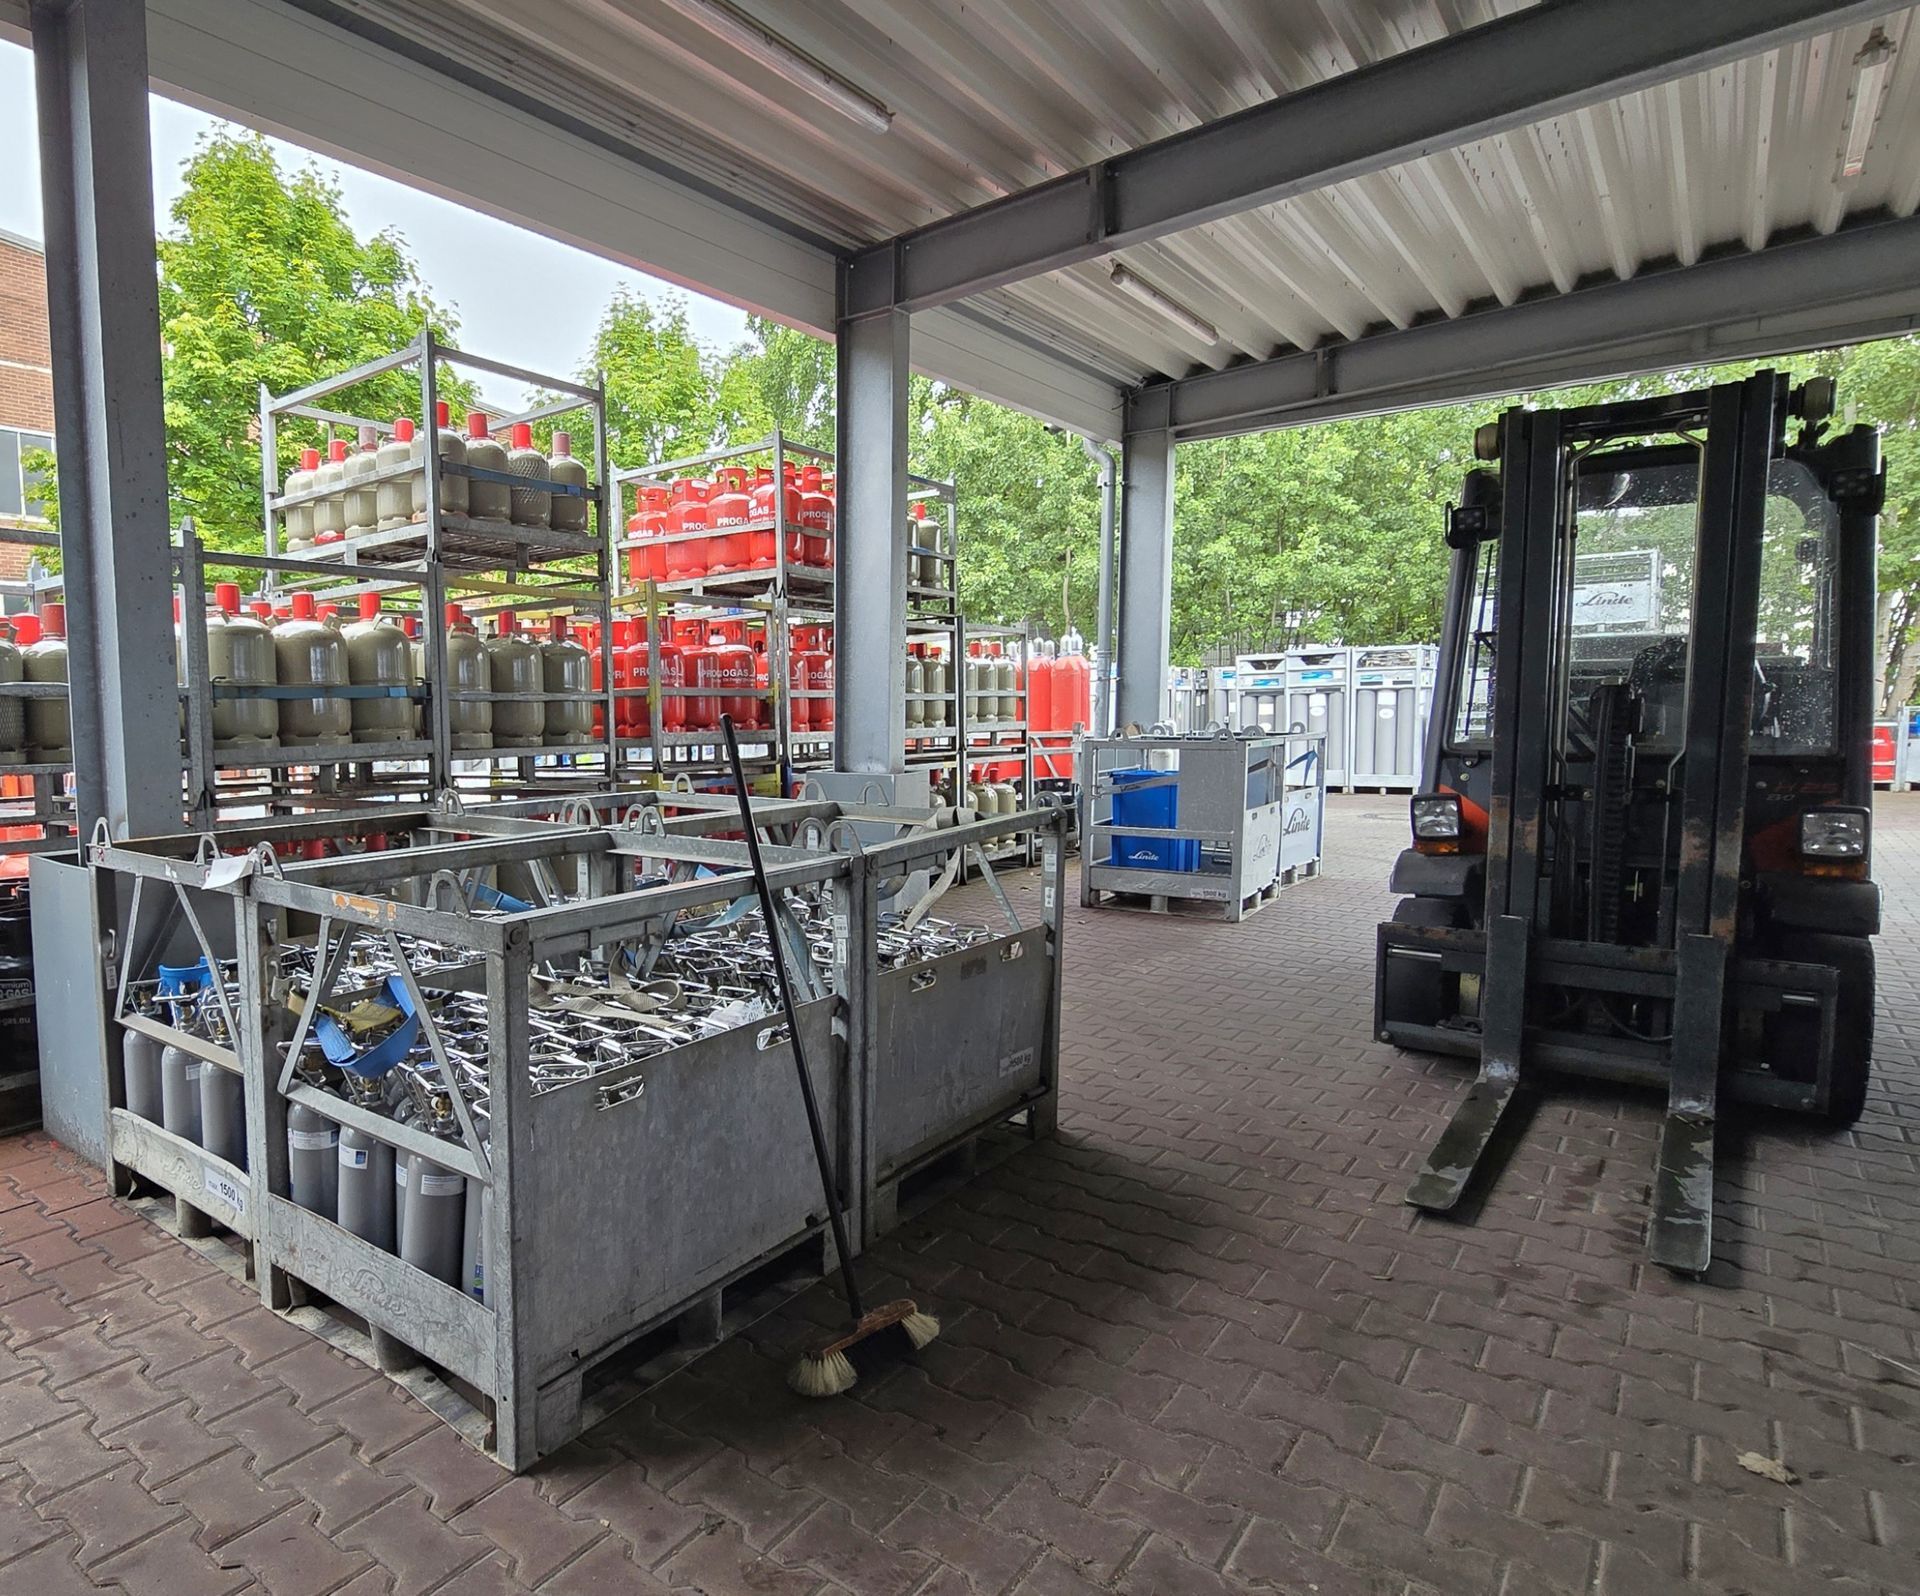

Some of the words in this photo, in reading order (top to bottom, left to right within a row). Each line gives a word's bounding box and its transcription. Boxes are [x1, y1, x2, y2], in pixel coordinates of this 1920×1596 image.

[1576, 591, 1633, 607] Linde
[1283, 807, 1311, 837] Linde
[1128, 850, 1160, 861] Linde
[220, 1182, 236, 1202] 1500
